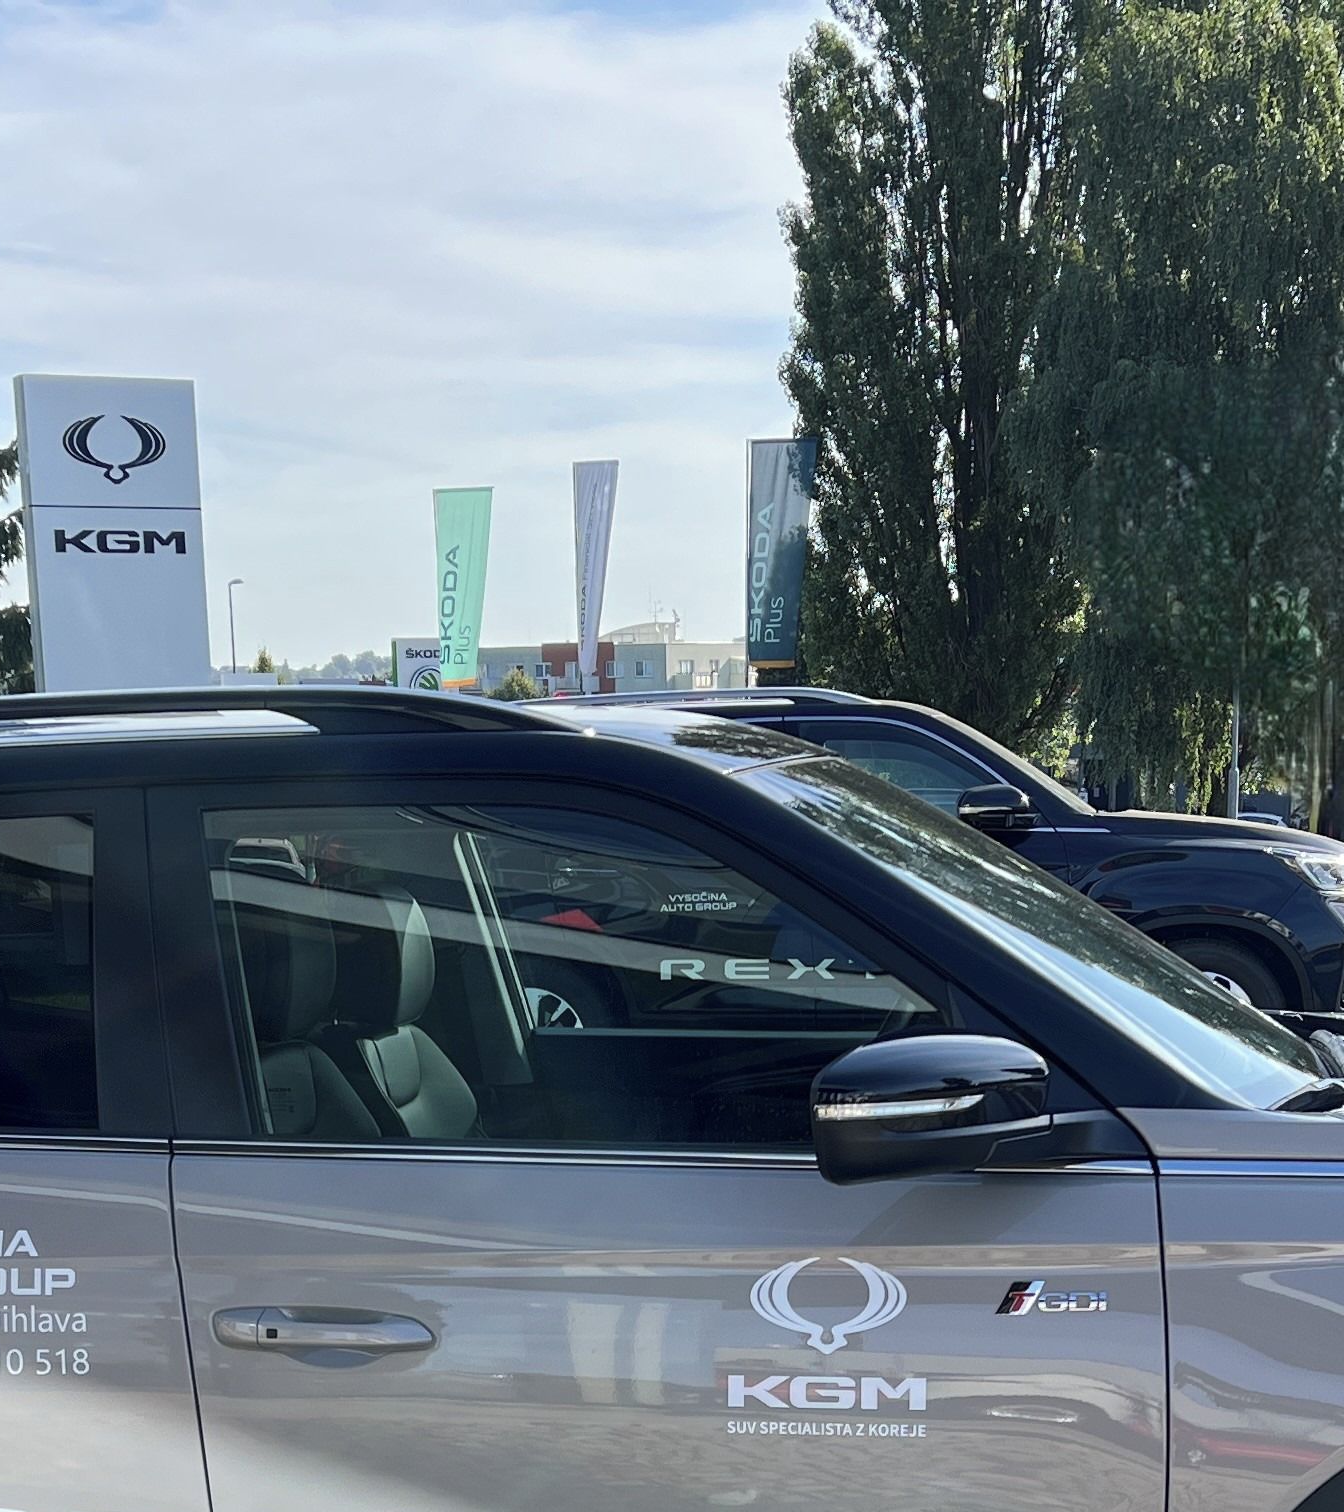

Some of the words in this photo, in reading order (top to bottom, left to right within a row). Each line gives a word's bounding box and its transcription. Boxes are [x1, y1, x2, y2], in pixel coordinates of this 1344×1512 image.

[55, 529, 187, 555] KGM
[764, 596, 784, 643] Plus
[405, 647, 440, 659] ŠKO
[453, 625, 471, 665] Plus
[659, 902, 693, 913] AUTO
[694, 902, 737, 912] GROUP
[34, 1348, 92, 1376] 518
[727, 1374, 927, 1411] KGM
[727, 1420, 757, 1436] SUV
[759, 1421, 853, 1438] SPECIALISTA
[855, 1422, 866, 1437] Z
[867, 1422, 927, 1439] KOREJE
